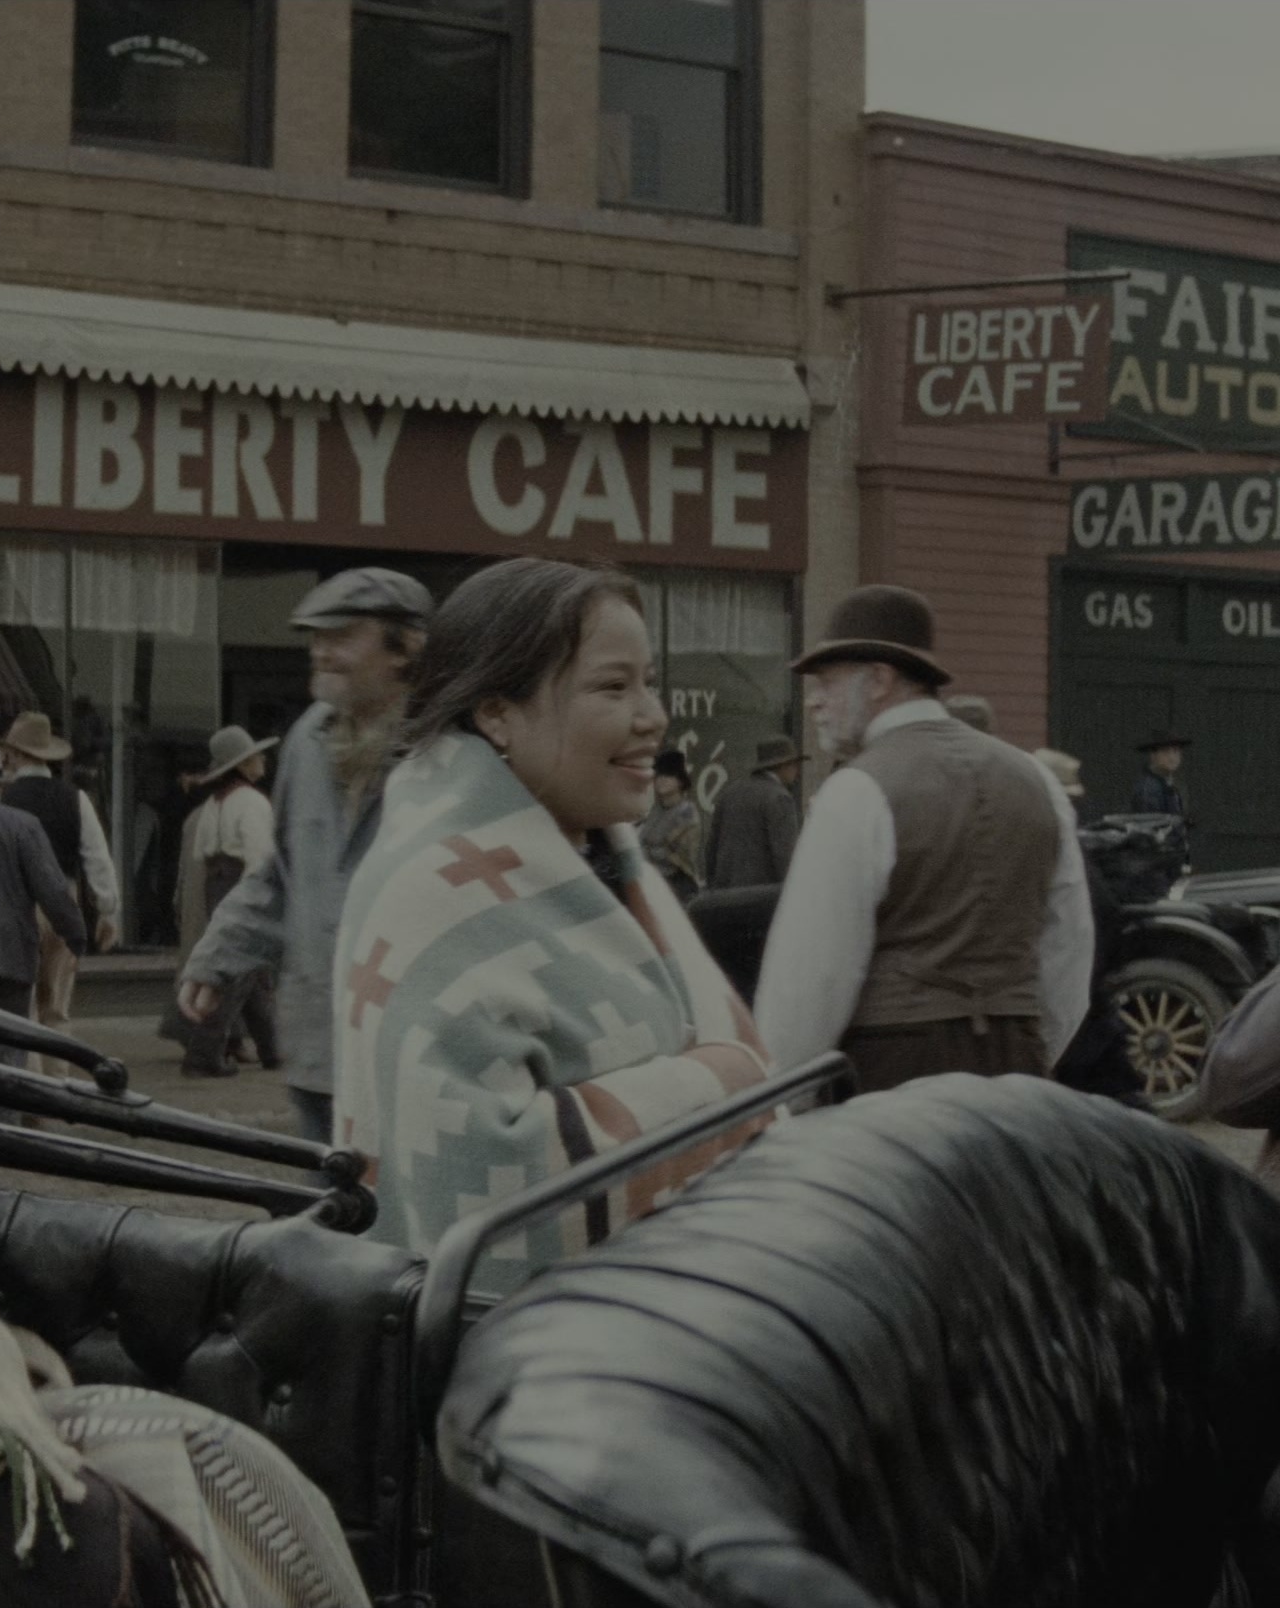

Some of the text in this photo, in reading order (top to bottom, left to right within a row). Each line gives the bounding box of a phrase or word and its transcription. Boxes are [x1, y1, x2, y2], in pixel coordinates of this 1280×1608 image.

[913, 304, 1100, 365] LIBERTY
[917, 361, 1084, 417] CAFE
[466, 412, 772, 552] CAFE
[1084, 590, 1154, 629] GAS
